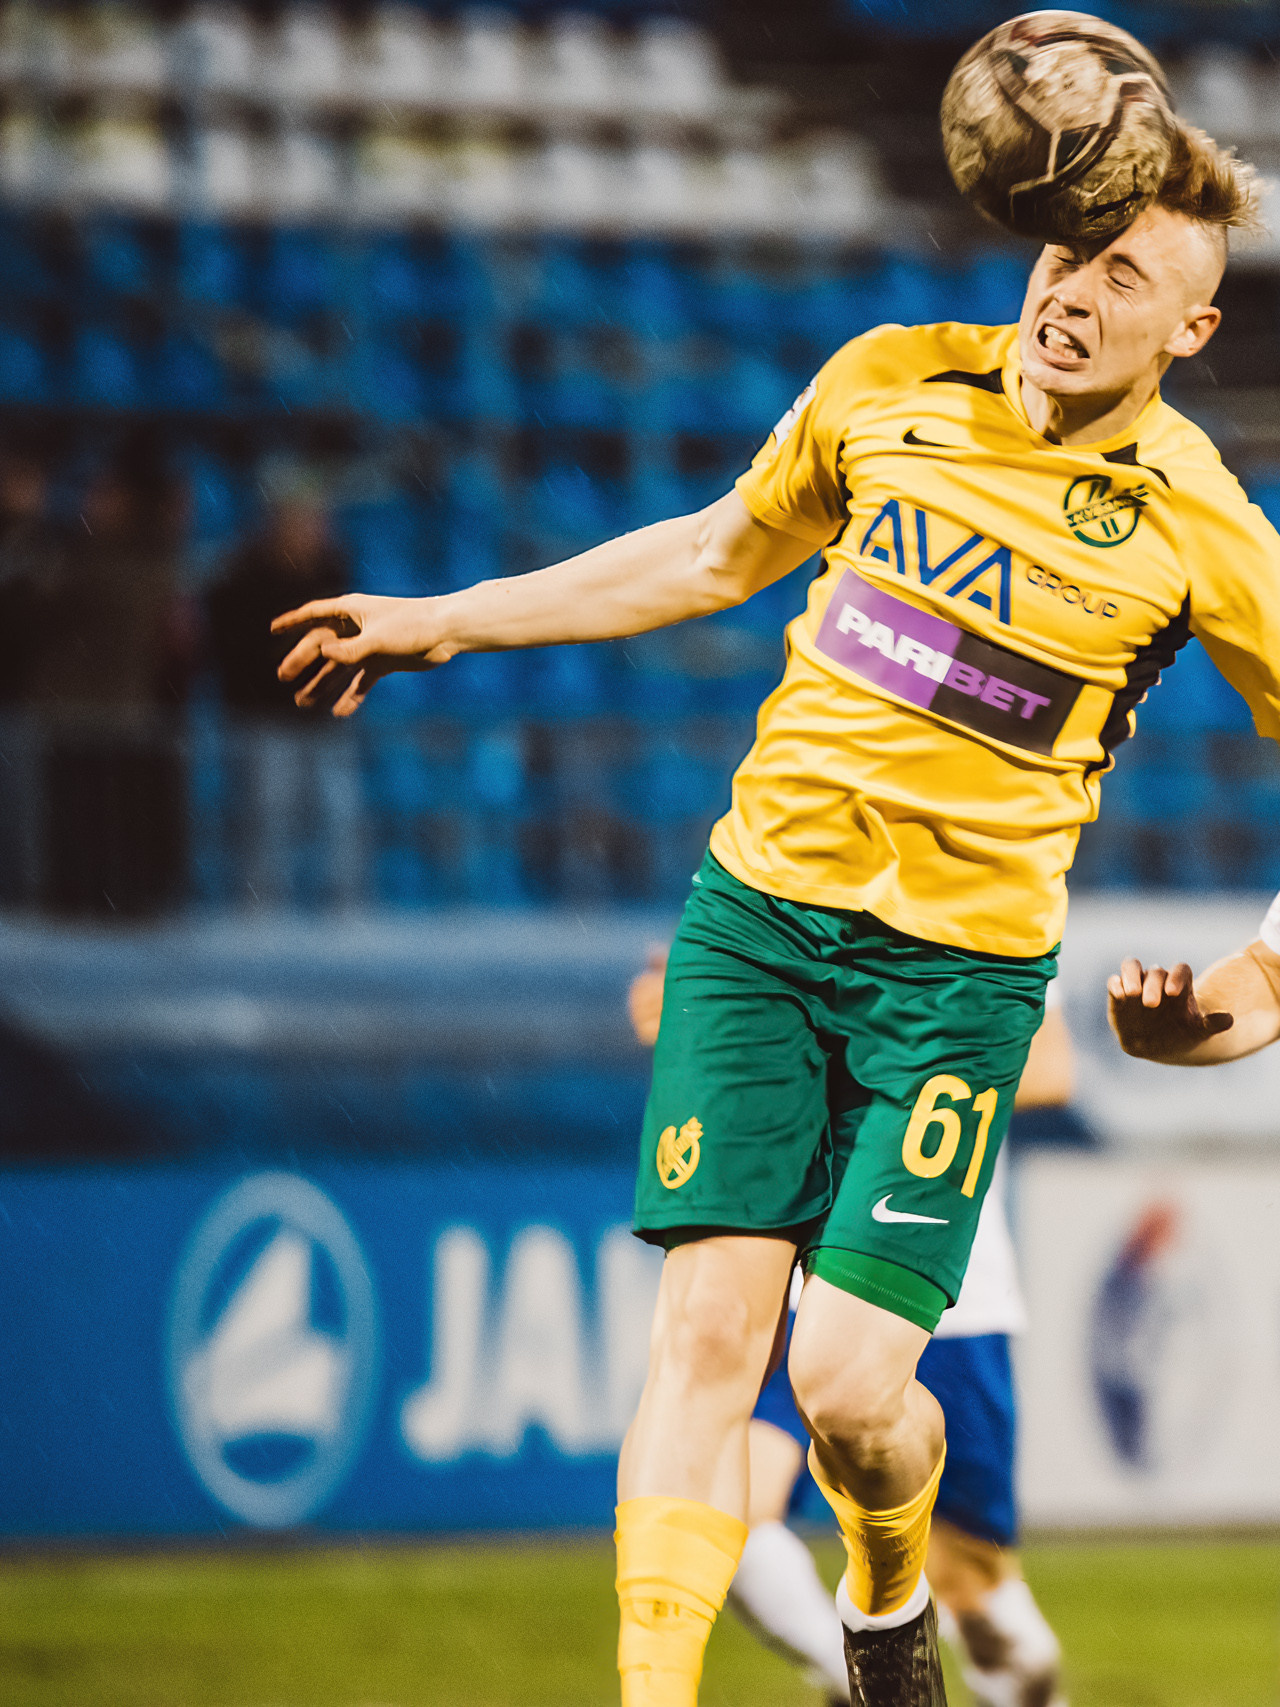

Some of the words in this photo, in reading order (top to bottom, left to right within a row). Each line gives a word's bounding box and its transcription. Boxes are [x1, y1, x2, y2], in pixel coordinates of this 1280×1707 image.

[860, 498, 1012, 625] AVA
[1026, 564, 1119, 618] GROUP
[836, 602, 1050, 719] PARIBET
[902, 1074, 999, 1198] 61
